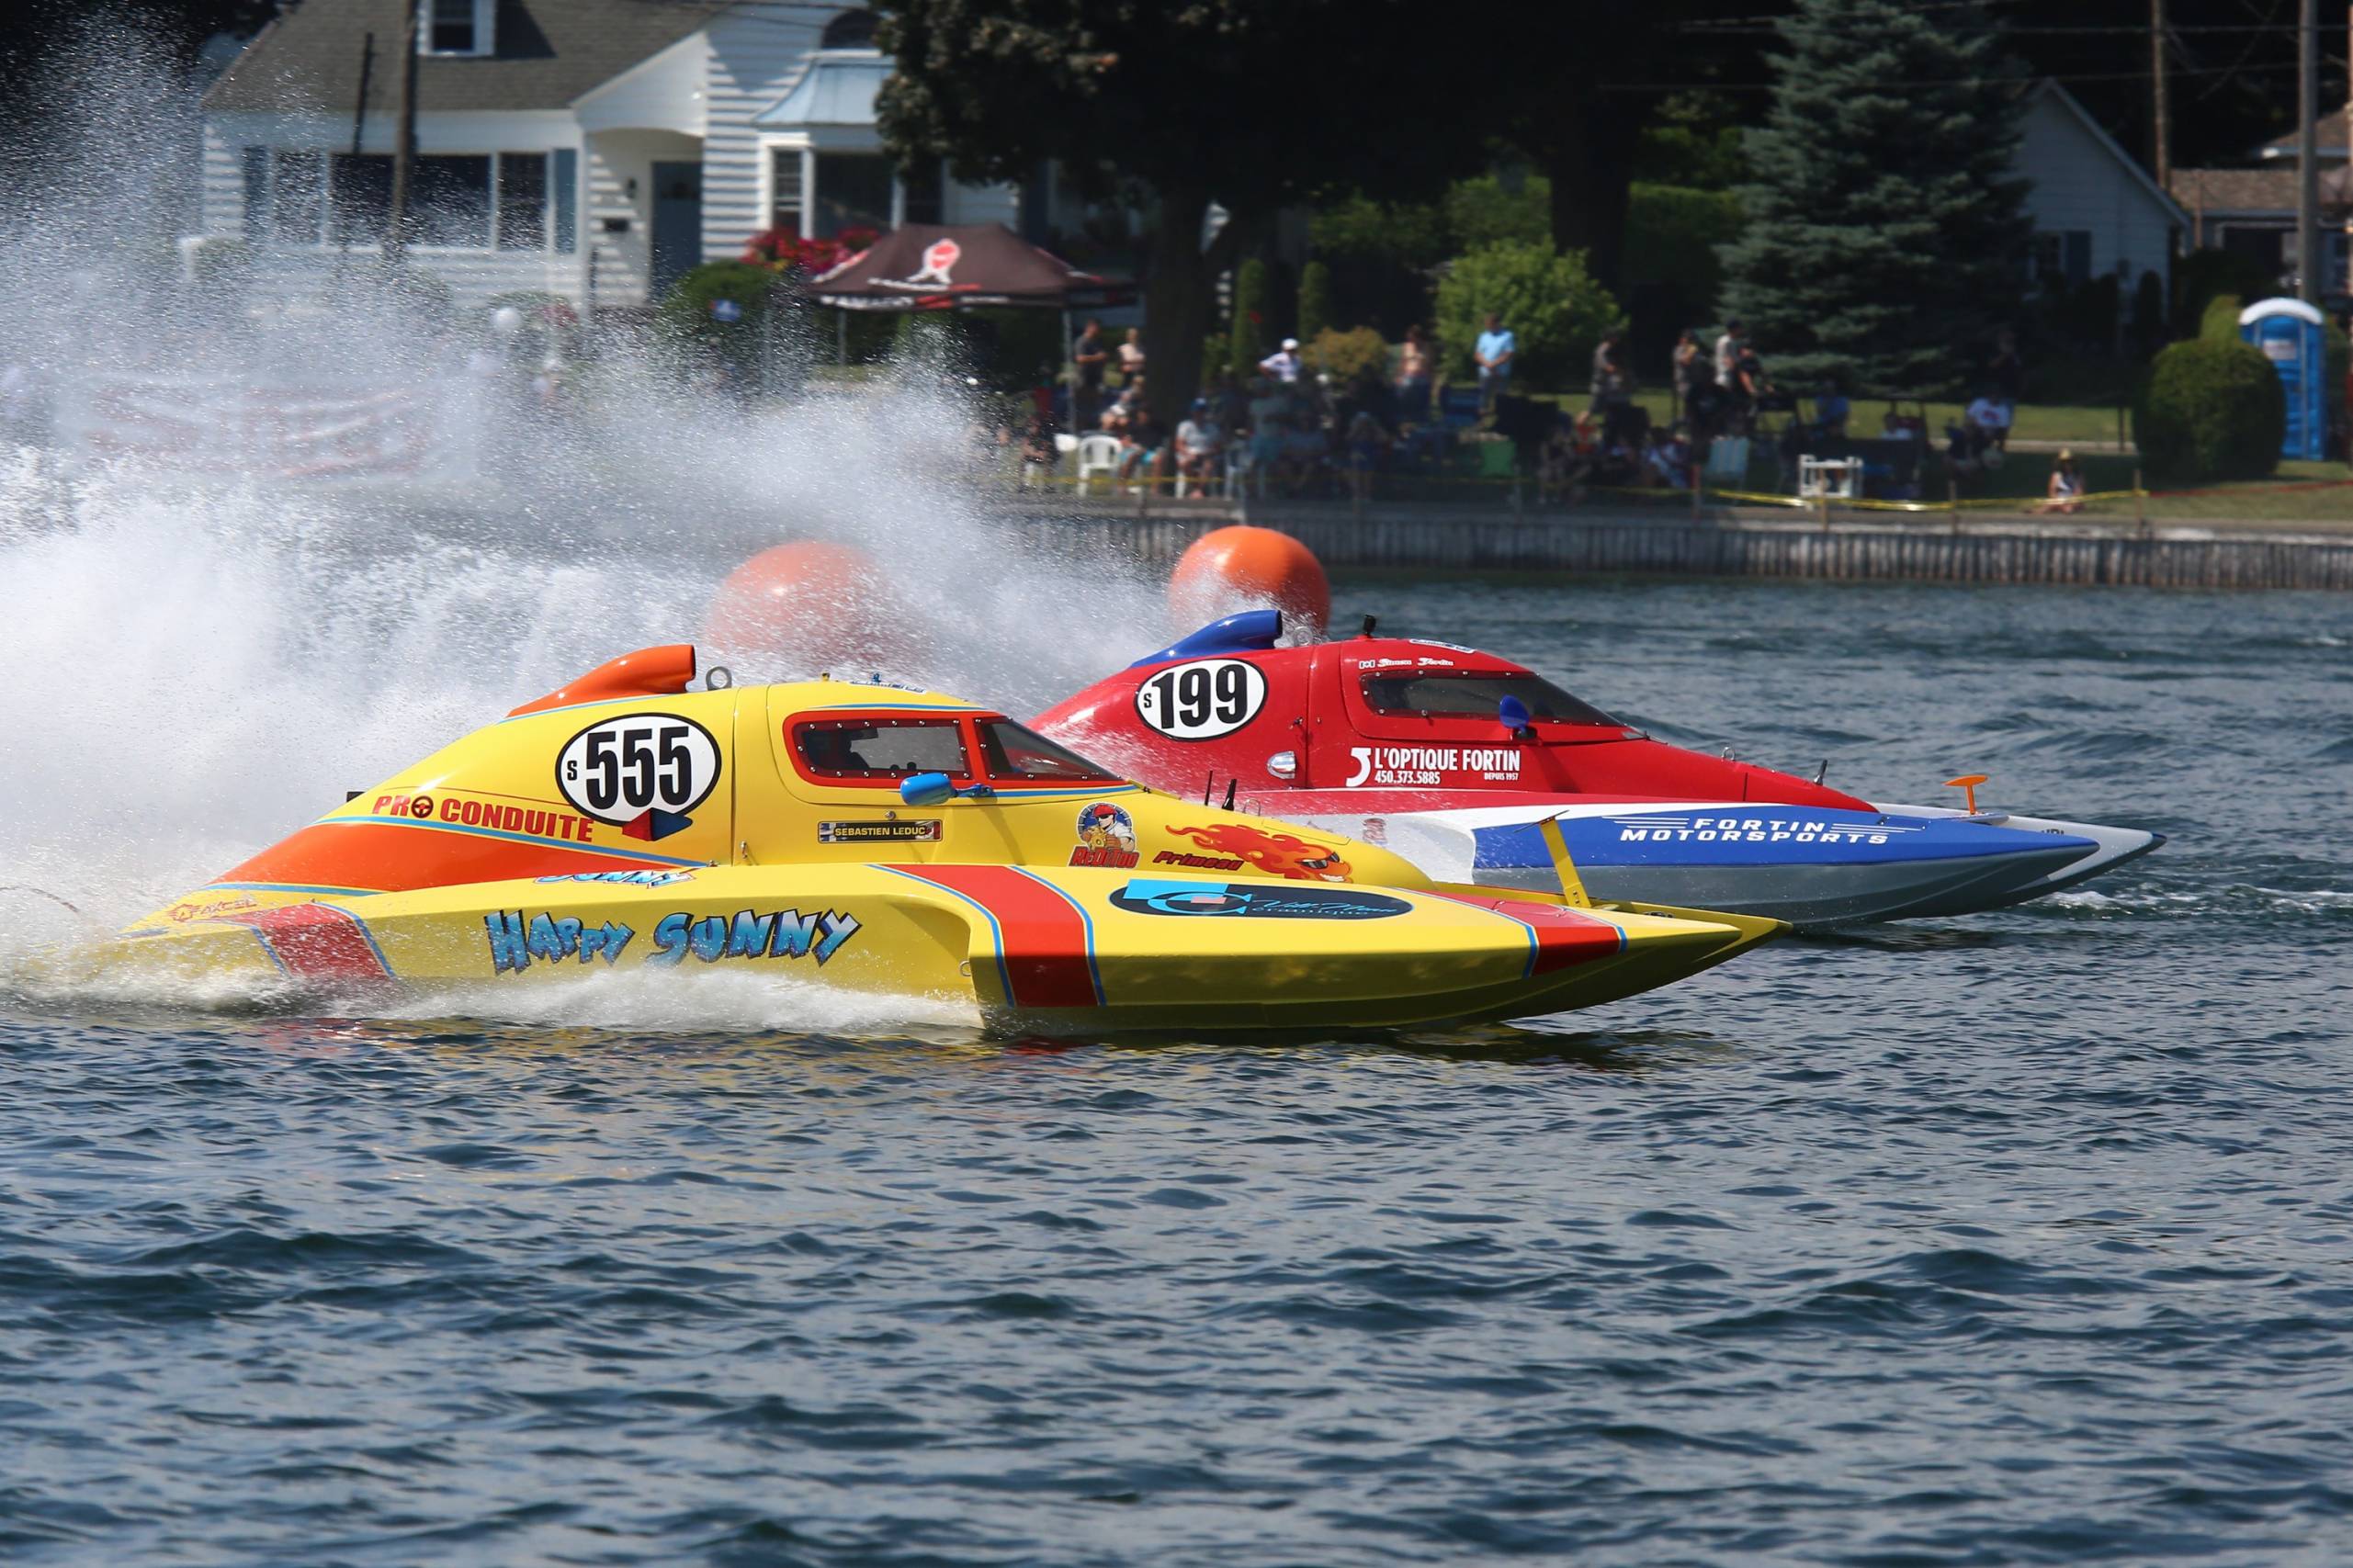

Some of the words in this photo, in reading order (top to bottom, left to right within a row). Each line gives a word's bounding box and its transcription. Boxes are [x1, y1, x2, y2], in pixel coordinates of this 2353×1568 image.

[1143, 693, 1152, 708] S
[1151, 664, 1248, 729] 199
[566, 760, 578, 781] S
[585, 726, 692, 809] 555
[1374, 747, 1458, 771] L'OPTIQUE
[1462, 750, 1521, 772] FORTIN
[1374, 770, 1441, 784] 450.373.5885
[1484, 772, 1505, 781] DEPUIS
[372, 795, 434, 818] PRO
[440, 798, 595, 842] CONDUITE
[1693, 818, 1826, 833] FORTIN
[834, 827, 890, 837] SEBASTIEN
[892, 826, 926, 836] LEDUC
[1620, 829, 1890, 845] MOTORSPORTS
[645, 908, 864, 969] SUNNY
